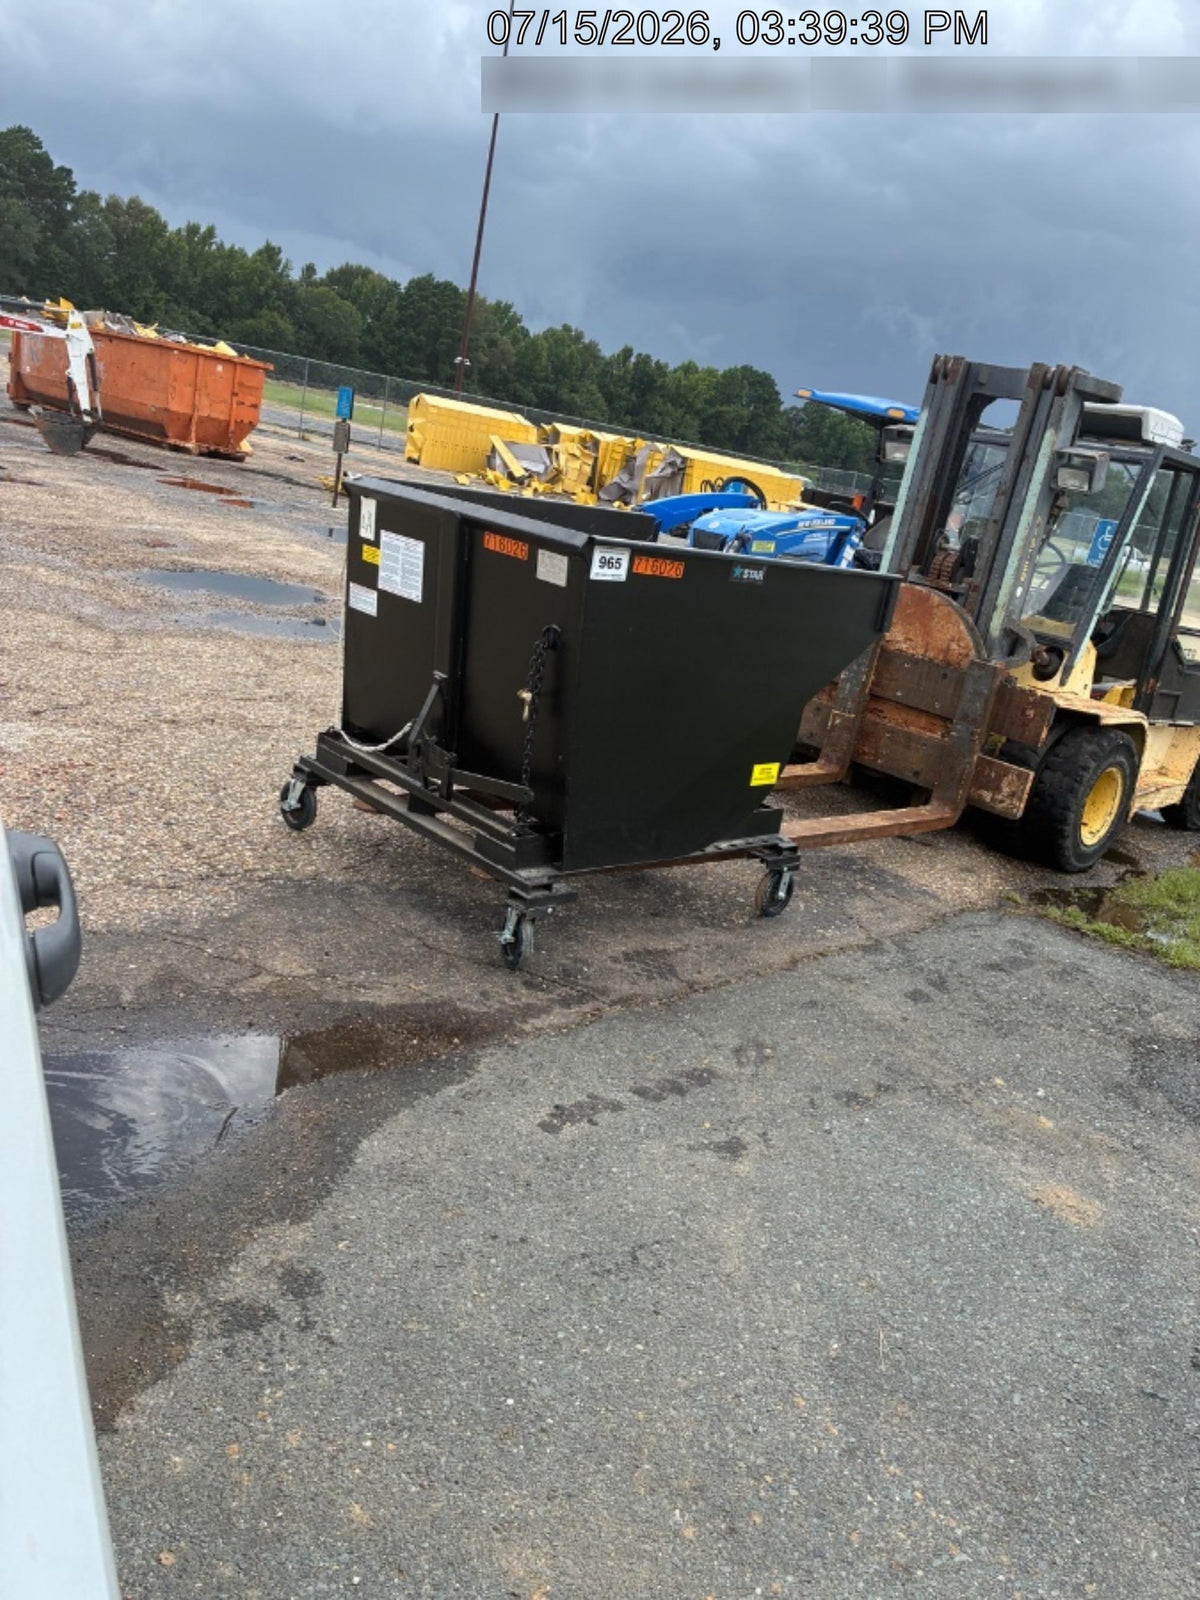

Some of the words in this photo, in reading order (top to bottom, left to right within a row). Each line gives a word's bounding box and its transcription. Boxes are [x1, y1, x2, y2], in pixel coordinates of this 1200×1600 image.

[484, 532, 527, 559] 716026
[598, 555, 623, 570] 965
[635, 556, 683, 577] 716026
